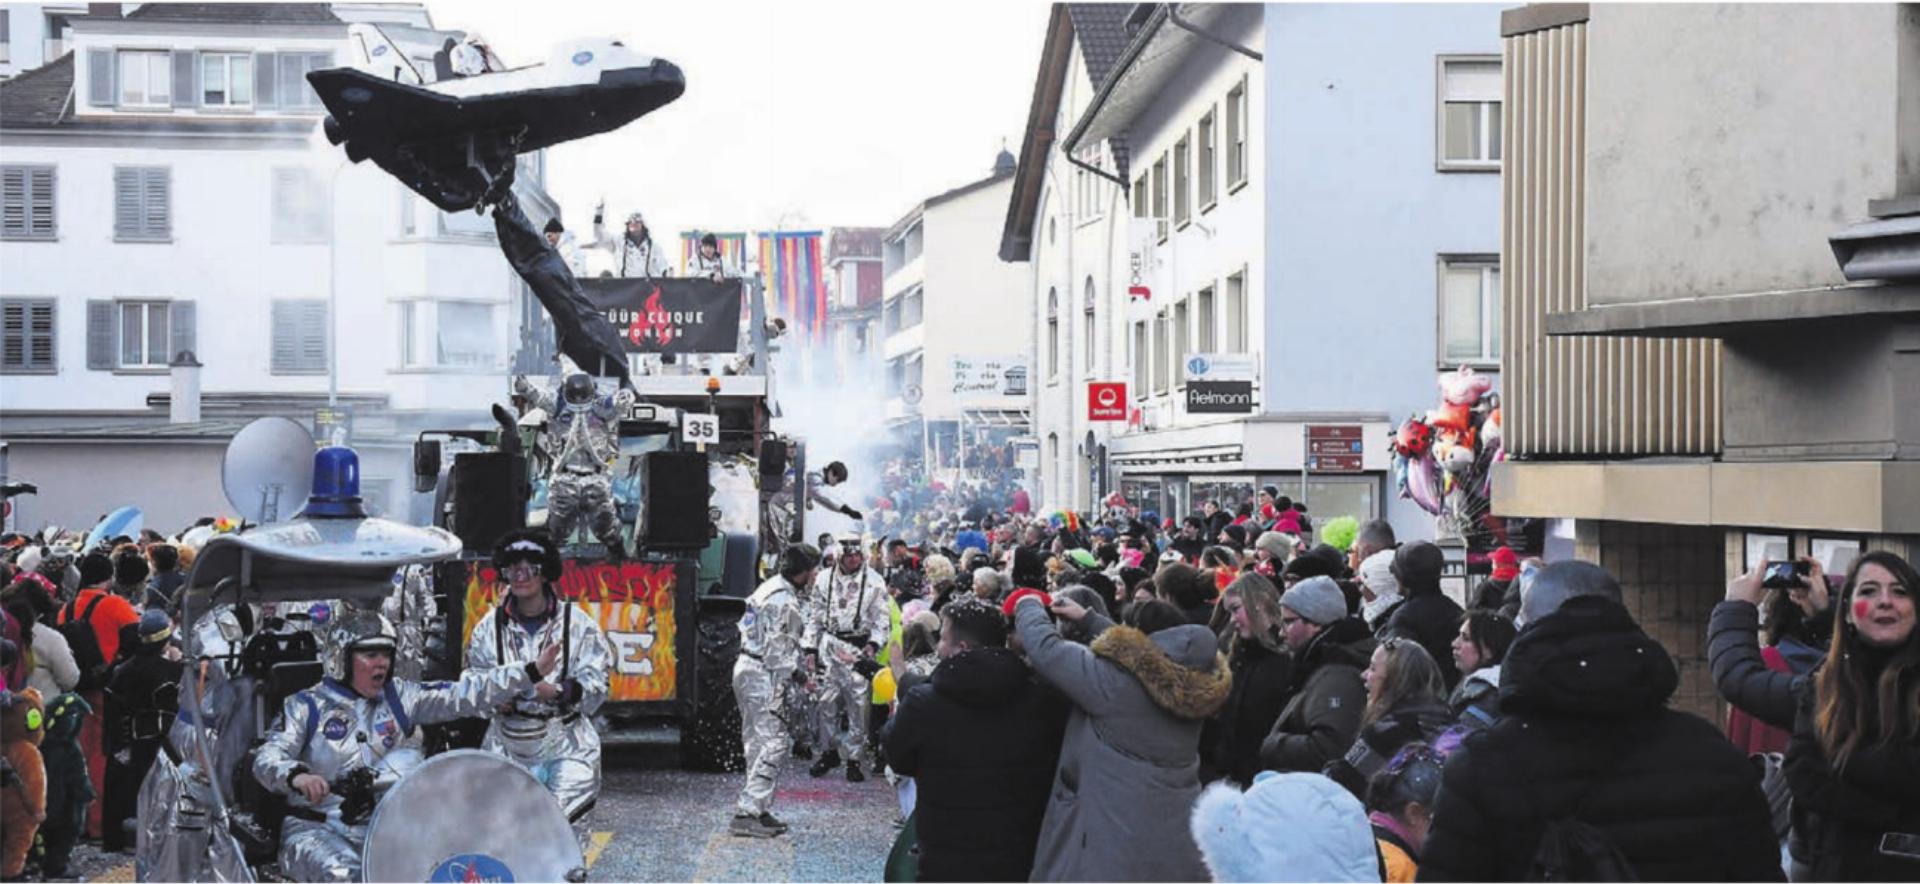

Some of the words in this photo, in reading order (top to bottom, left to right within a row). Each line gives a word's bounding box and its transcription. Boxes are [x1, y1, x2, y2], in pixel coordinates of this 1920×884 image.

[599, 308, 640, 324] ÜÜR
[648, 311, 704, 325] CLIQUE
[1190, 389, 1250, 405] Fielmann
[689, 420, 714, 438] 35
